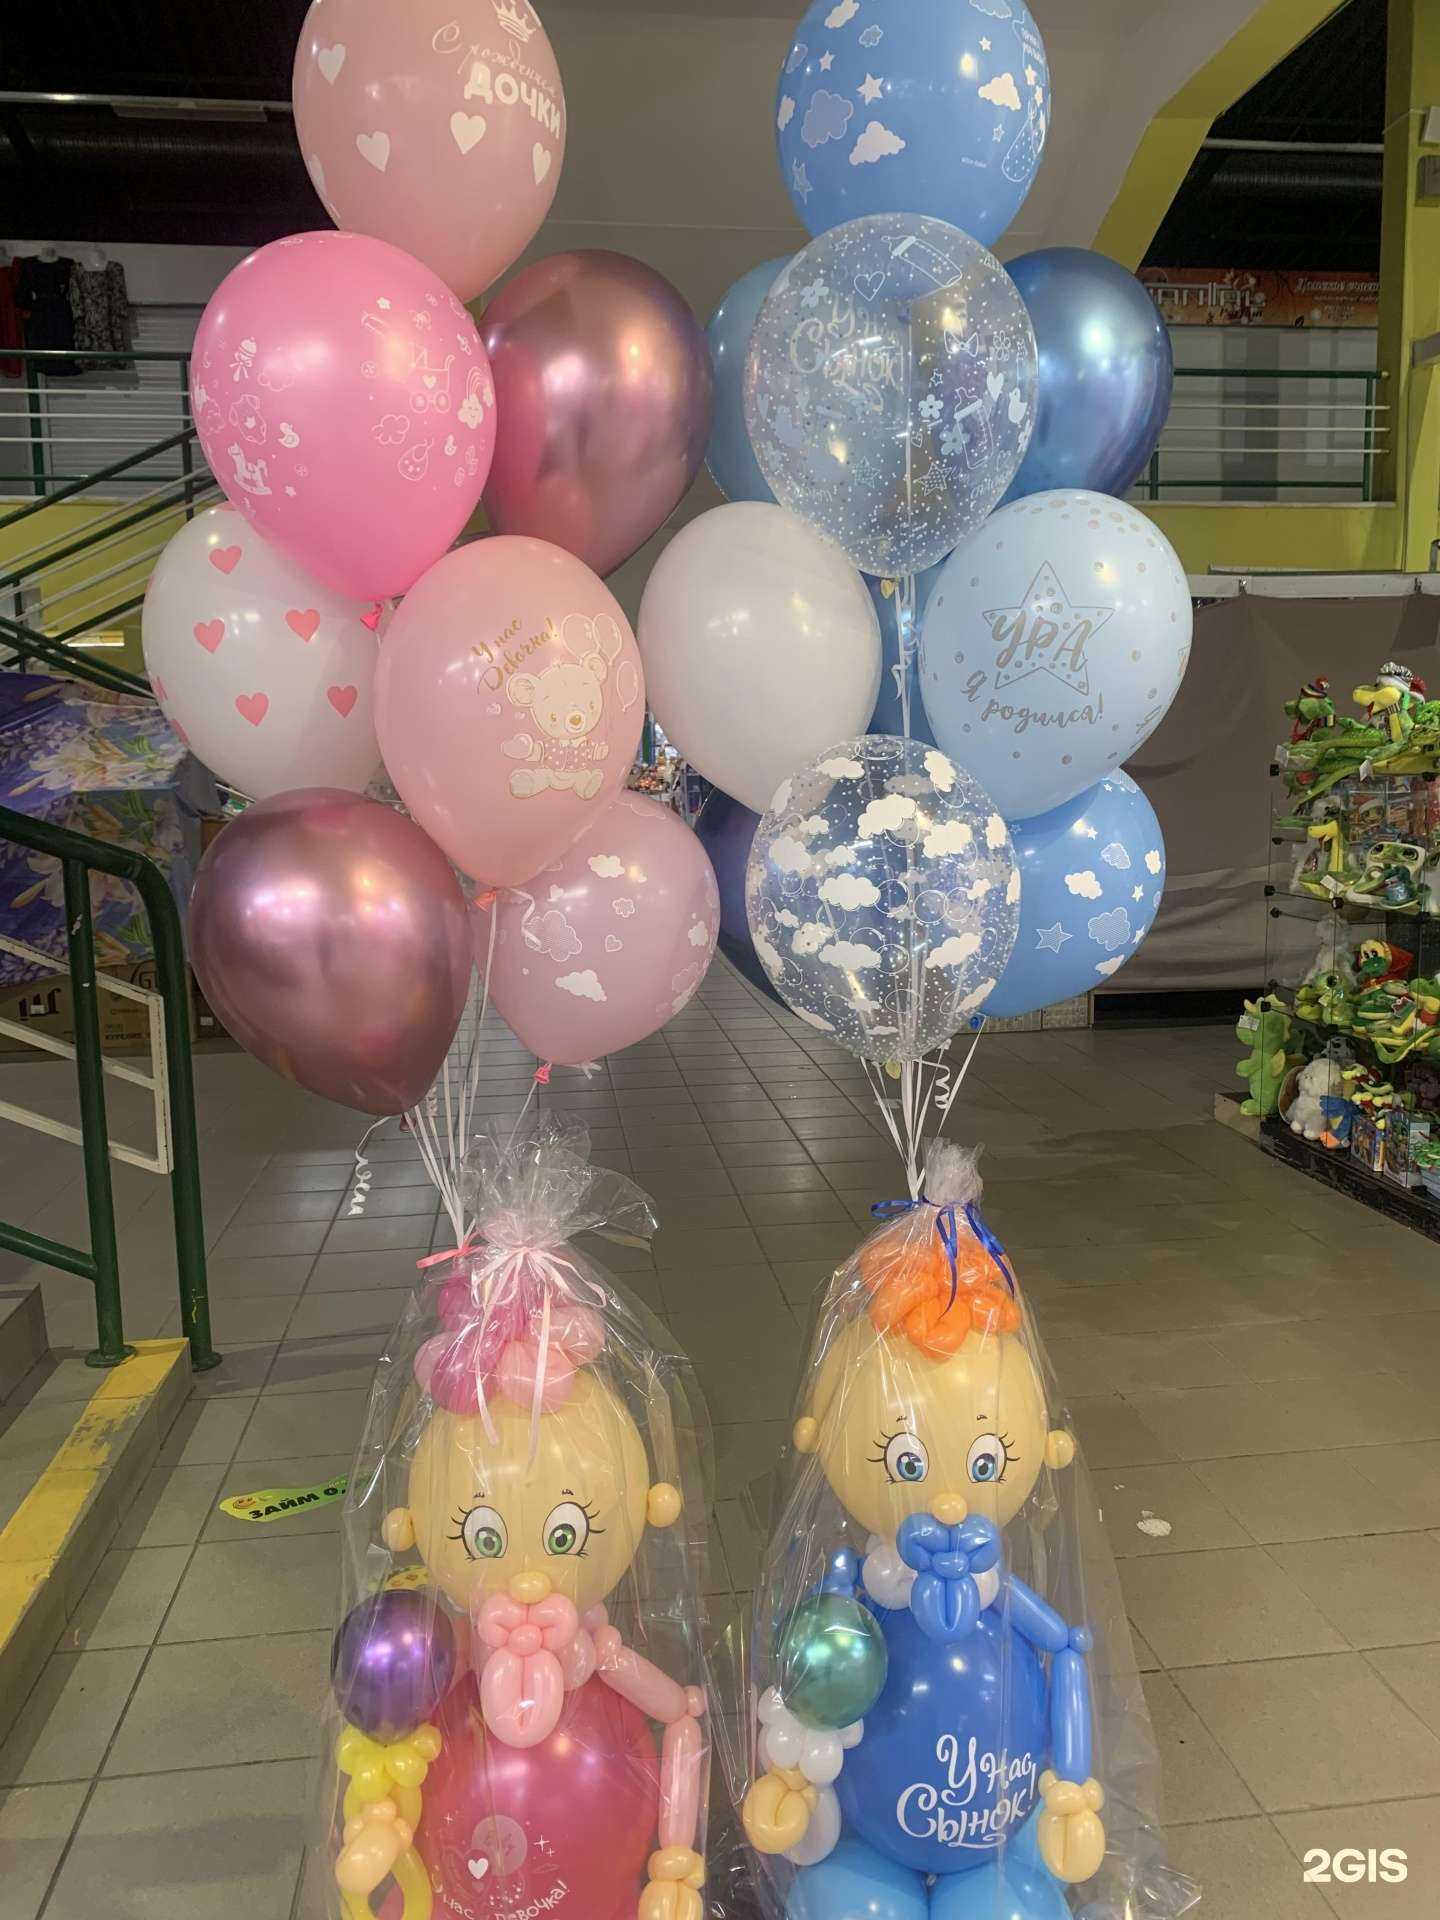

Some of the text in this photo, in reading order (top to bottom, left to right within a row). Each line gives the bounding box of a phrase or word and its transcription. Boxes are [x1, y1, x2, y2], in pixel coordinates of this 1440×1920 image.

[463, 61, 561, 140] ДОЧКИ
[992, 610, 1093, 673] УРА
[248, 1493, 320, 1520] ЗАЙМ
[936, 1733, 977, 1806] У
